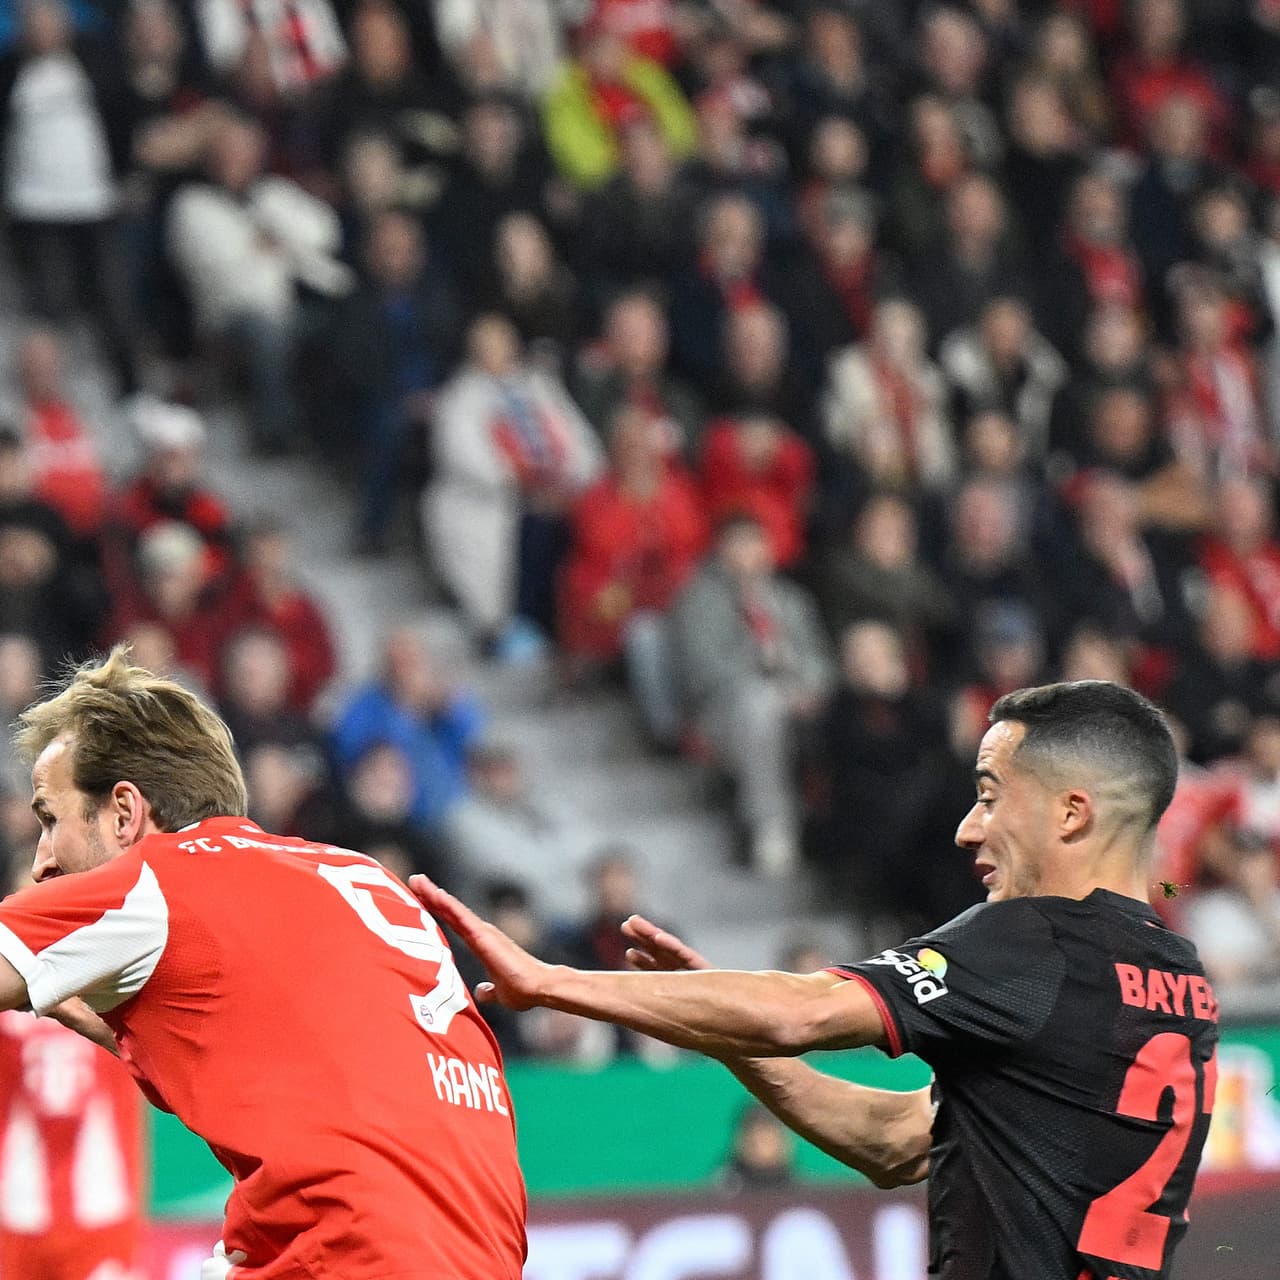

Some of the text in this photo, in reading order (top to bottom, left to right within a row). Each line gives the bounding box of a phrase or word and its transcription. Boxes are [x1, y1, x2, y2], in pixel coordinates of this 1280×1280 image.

[316, 861, 470, 1035] 9
[1114, 963, 1218, 1024] BAYE
[426, 1052, 508, 1116] KANE
